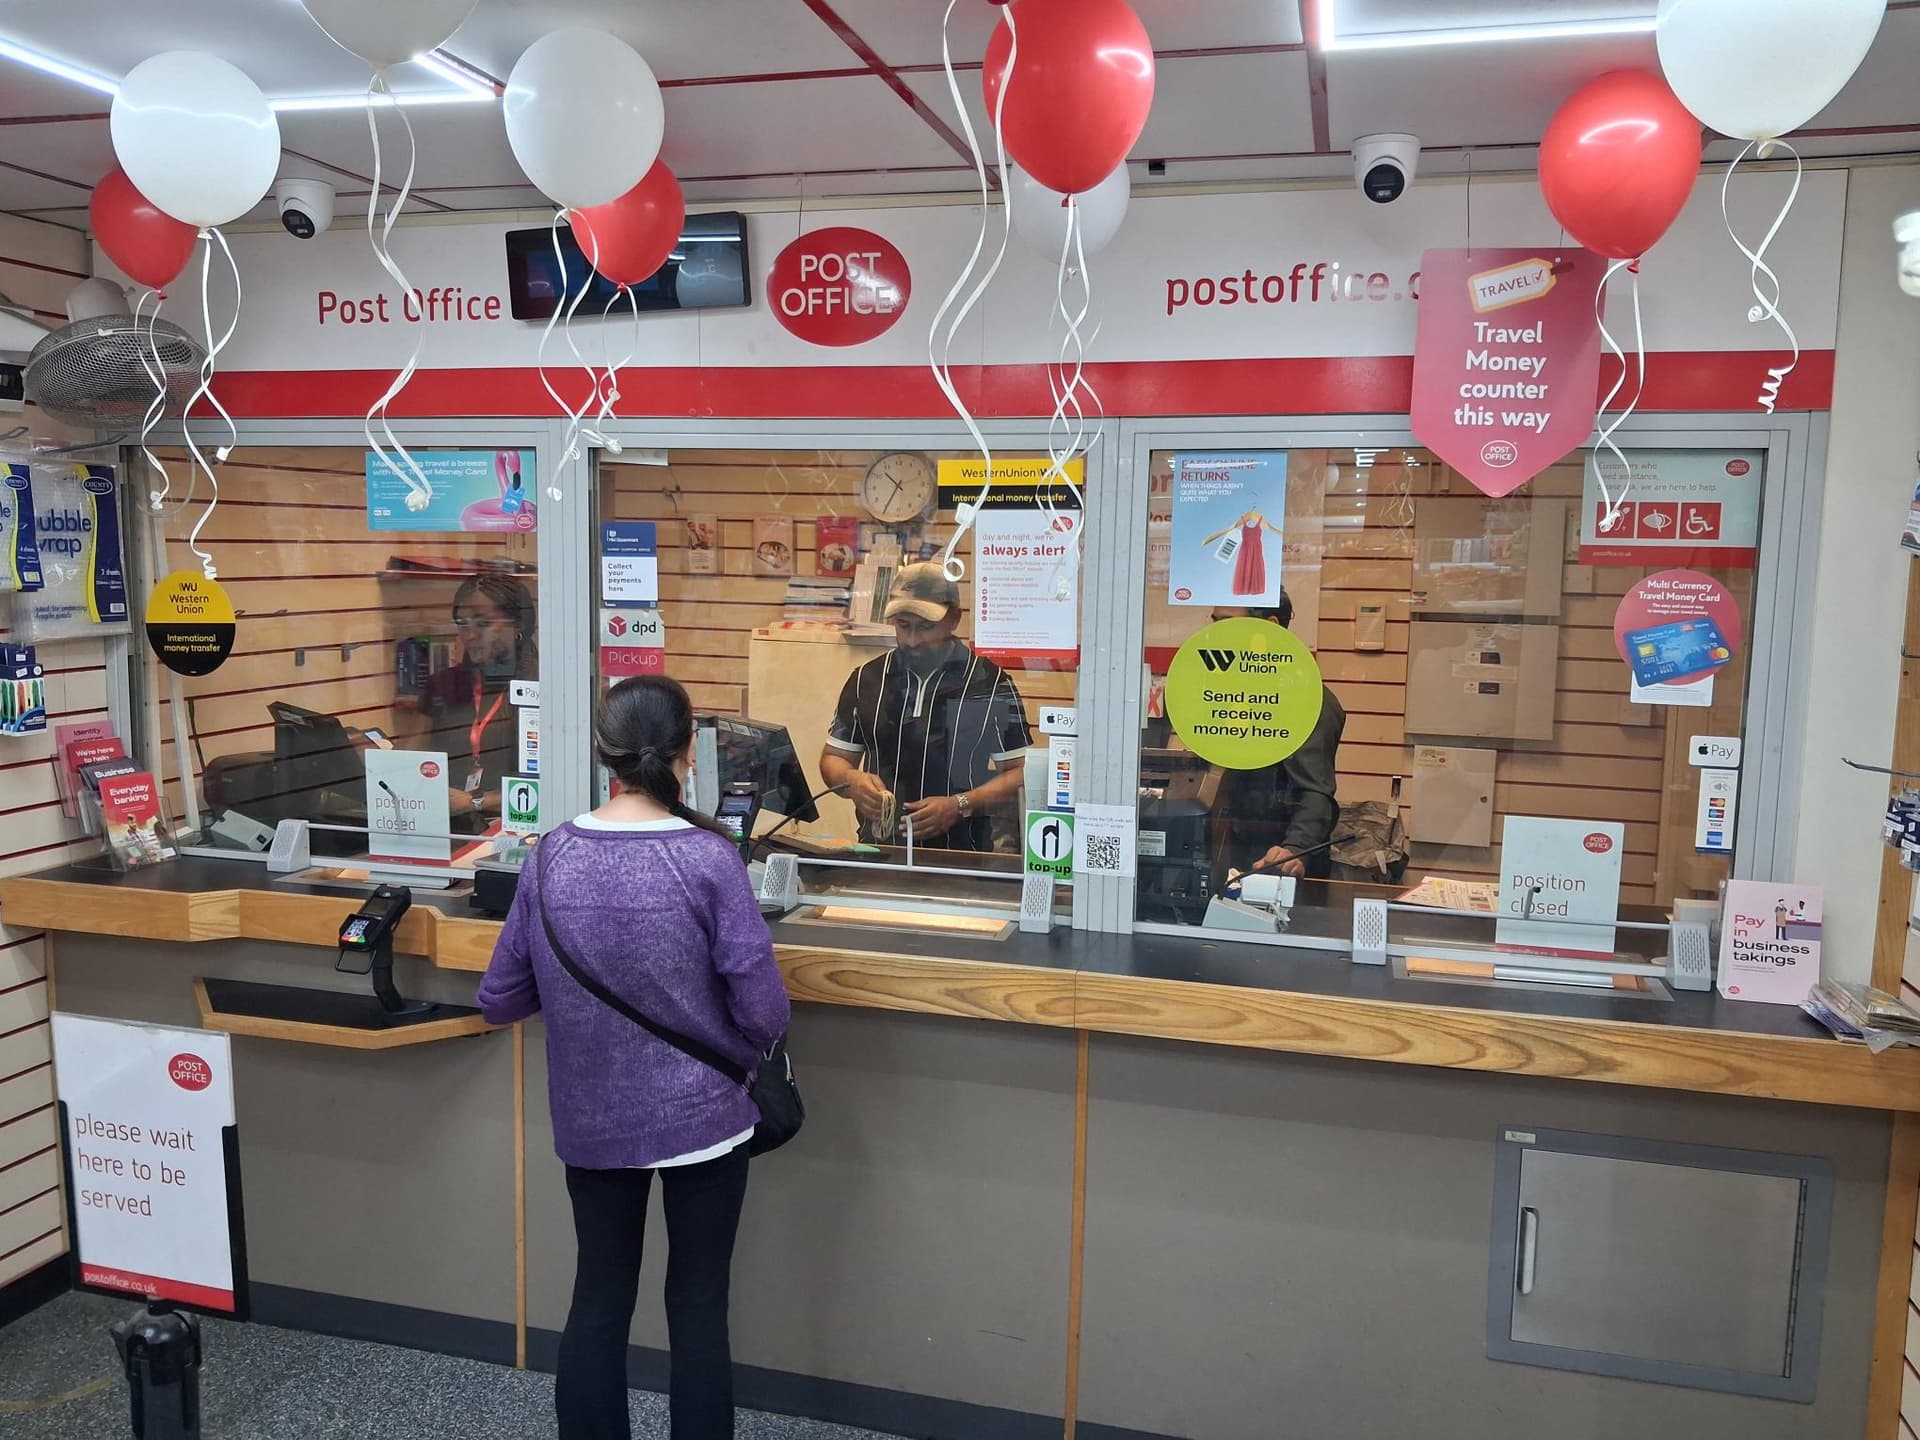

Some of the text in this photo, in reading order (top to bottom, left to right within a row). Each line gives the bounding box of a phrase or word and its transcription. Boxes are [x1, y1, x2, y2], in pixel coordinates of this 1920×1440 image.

[800, 252, 881, 282] POST
[1480, 274, 1531, 299] TRAVEL
[318, 286, 501, 325] Post Office
[780, 286, 894, 317] OFFICE
[1473, 320, 1543, 344] Travel
[1465, 348, 1547, 378] Money
[1459, 381, 1549, 400] counter
[1454, 403, 1552, 434] this way
[1485, 452, 1513, 461] OFFICE
[1490, 445, 1511, 454] POST
[1181, 471, 1230, 482] RETURNS
[1006, 495, 1033, 505] money
[38, 508, 92, 532] ubble
[982, 544, 1067, 558] always alert
[1647, 580, 1713, 591] Multi Currency
[169, 594, 210, 603] Western
[1638, 591, 1721, 603] Travel Money Card
[176, 603, 204, 614] Union
[631, 620, 657, 636] dpd
[167, 633, 217, 642] International
[163, 644, 221, 653] money transfer
[608, 651, 658, 667] Pickup
[1239, 650, 1293, 663] Western
[1239, 662, 1277, 673] Union
[525, 688, 540, 699] Pay
[1203, 689, 1280, 705] Send and
[1057, 714, 1076, 727] Pay
[1211, 709, 1272, 721] receive
[73, 728, 102, 737] Identity
[1192, 725, 1290, 738] money here
[1711, 744, 1735, 759] Pay
[94, 766, 136, 779] Business
[110, 784, 150, 796] Everyday
[114, 793, 150, 805] banking
[376, 815, 417, 831] closed
[510, 811, 537, 822] top-up
[1029, 860, 1072, 874] top-up
[1512, 873, 1587, 892] position
[1510, 896, 1568, 916] closed
[1734, 914, 1765, 928] Pay
[1734, 927, 1748, 937] in
[1733, 939, 1811, 955] business
[1733, 952, 1797, 967] takings
[177, 1060, 202, 1072] POST
[172, 1070, 207, 1084] OFFICE
[75, 1113, 196, 1151] please wait
[78, 1147, 187, 1187] here to be
[80, 1188, 153, 1217] served
[84, 1271, 158, 1295] postoffice.co.uk
